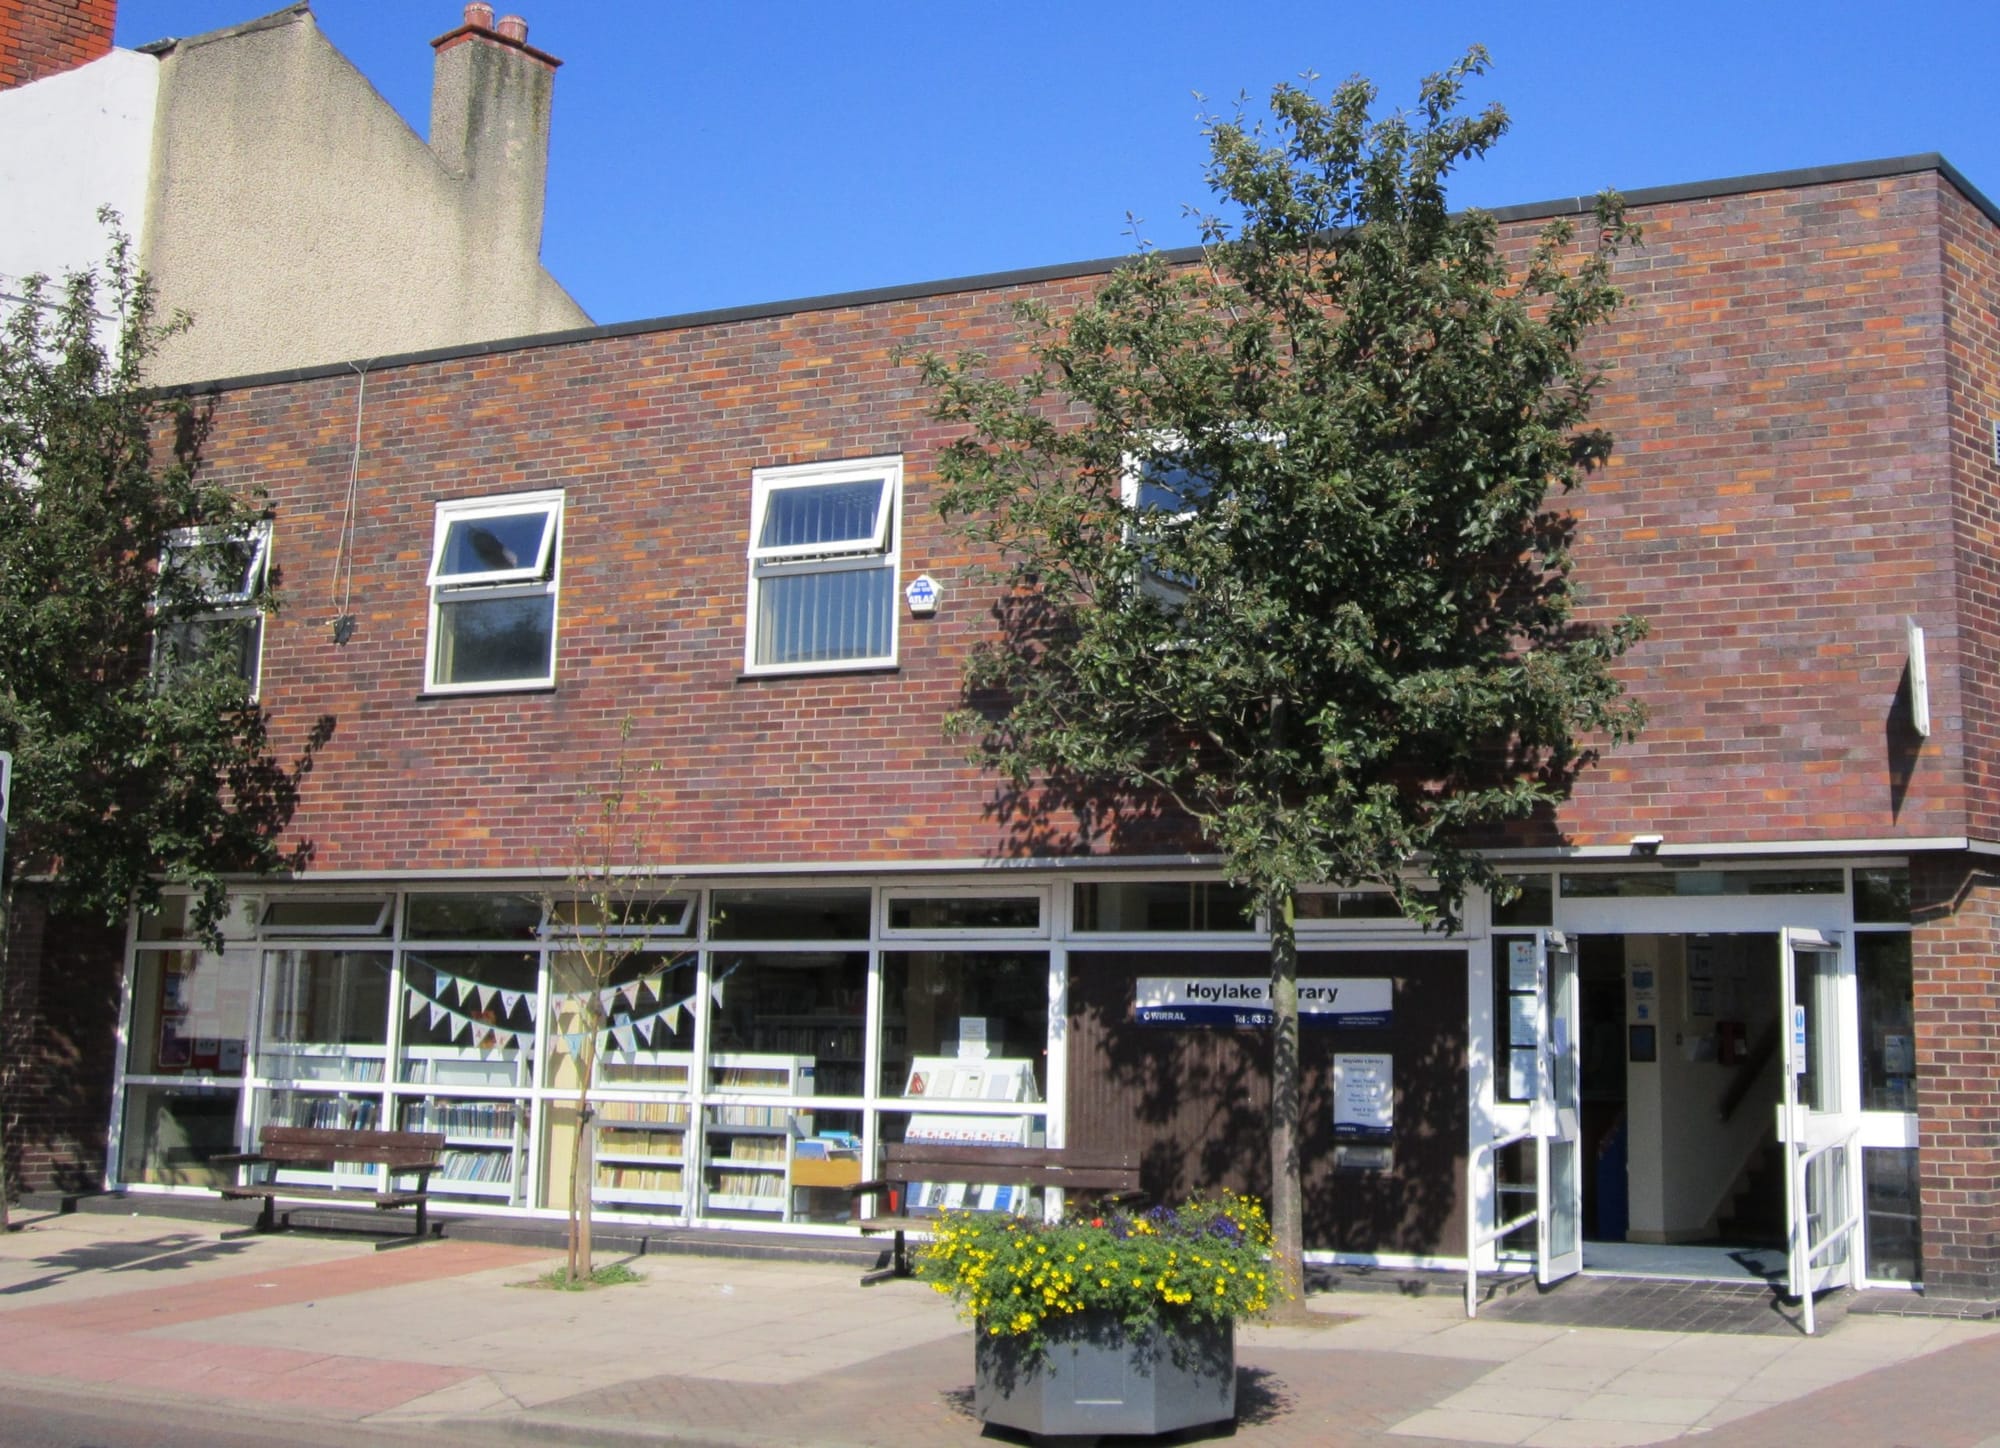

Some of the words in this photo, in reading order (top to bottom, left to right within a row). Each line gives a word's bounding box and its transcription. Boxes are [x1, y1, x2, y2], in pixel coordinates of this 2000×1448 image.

[1186, 983, 1262, 1002] Hoylake
[1268, 983, 1339, 1003] rary
[1151, 1011, 1186, 1021] WIRRAL
